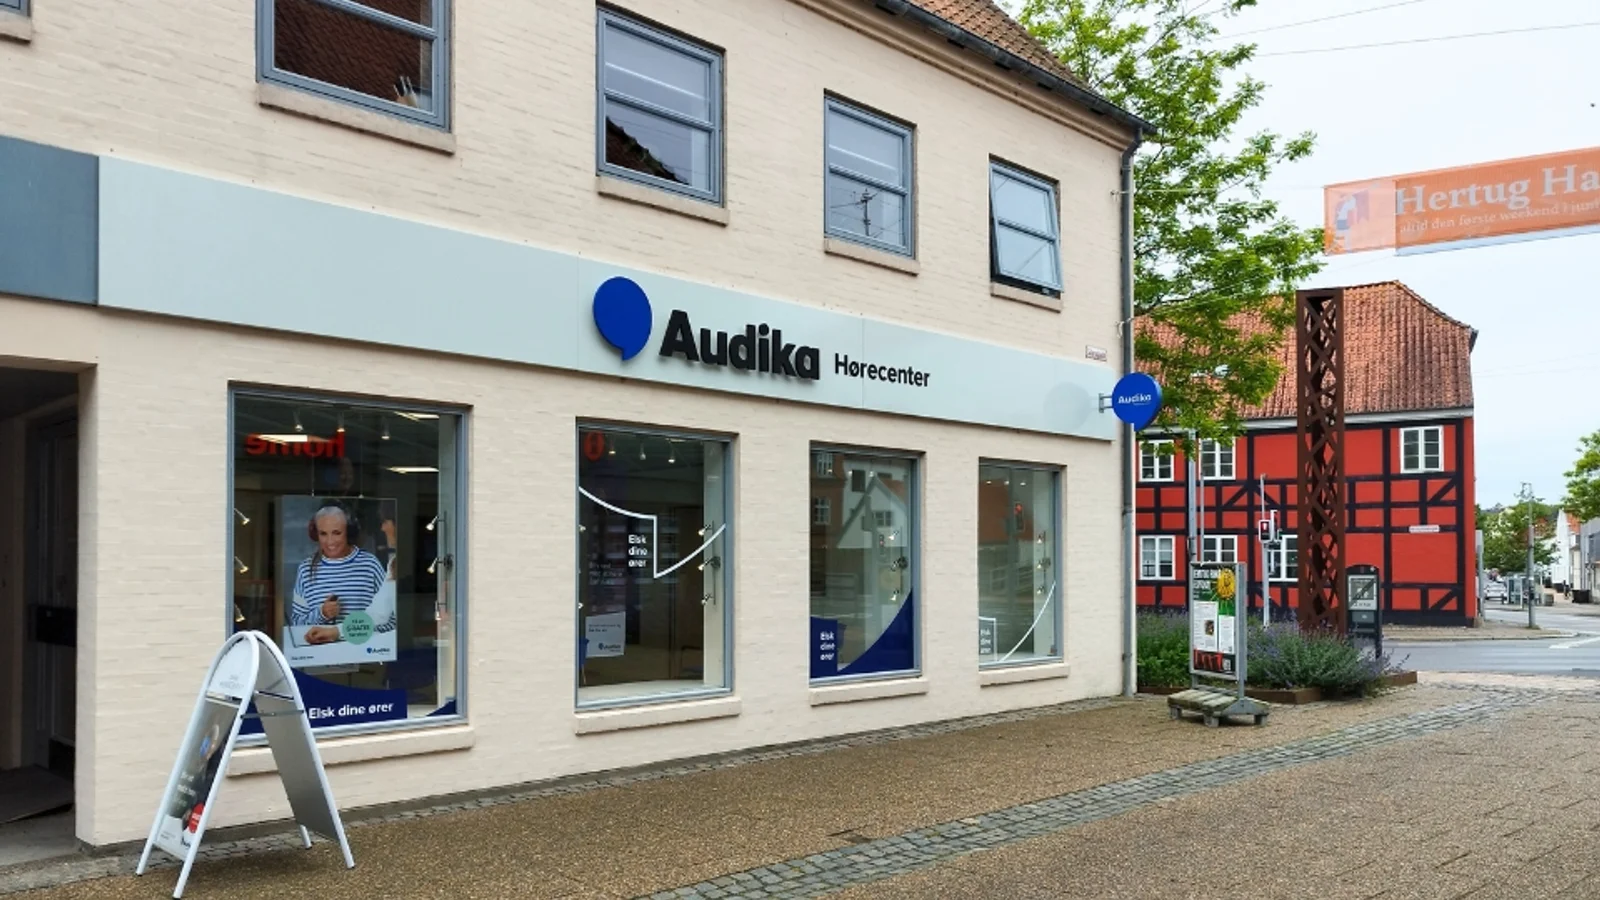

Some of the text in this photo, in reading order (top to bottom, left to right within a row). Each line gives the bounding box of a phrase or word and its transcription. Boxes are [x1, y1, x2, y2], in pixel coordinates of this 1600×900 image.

[1395, 179, 1531, 215] Hertug
[1432, 217, 1454, 230] den
[1501, 202, 1560, 220] weekend
[658, 309, 931, 387] Audika Hørecenter
[1118, 393, 1152, 404] Audika
[628, 534, 647, 544] Elsk
[628, 546, 648, 556] dine
[309, 703, 395, 719] Elsk dine ører
